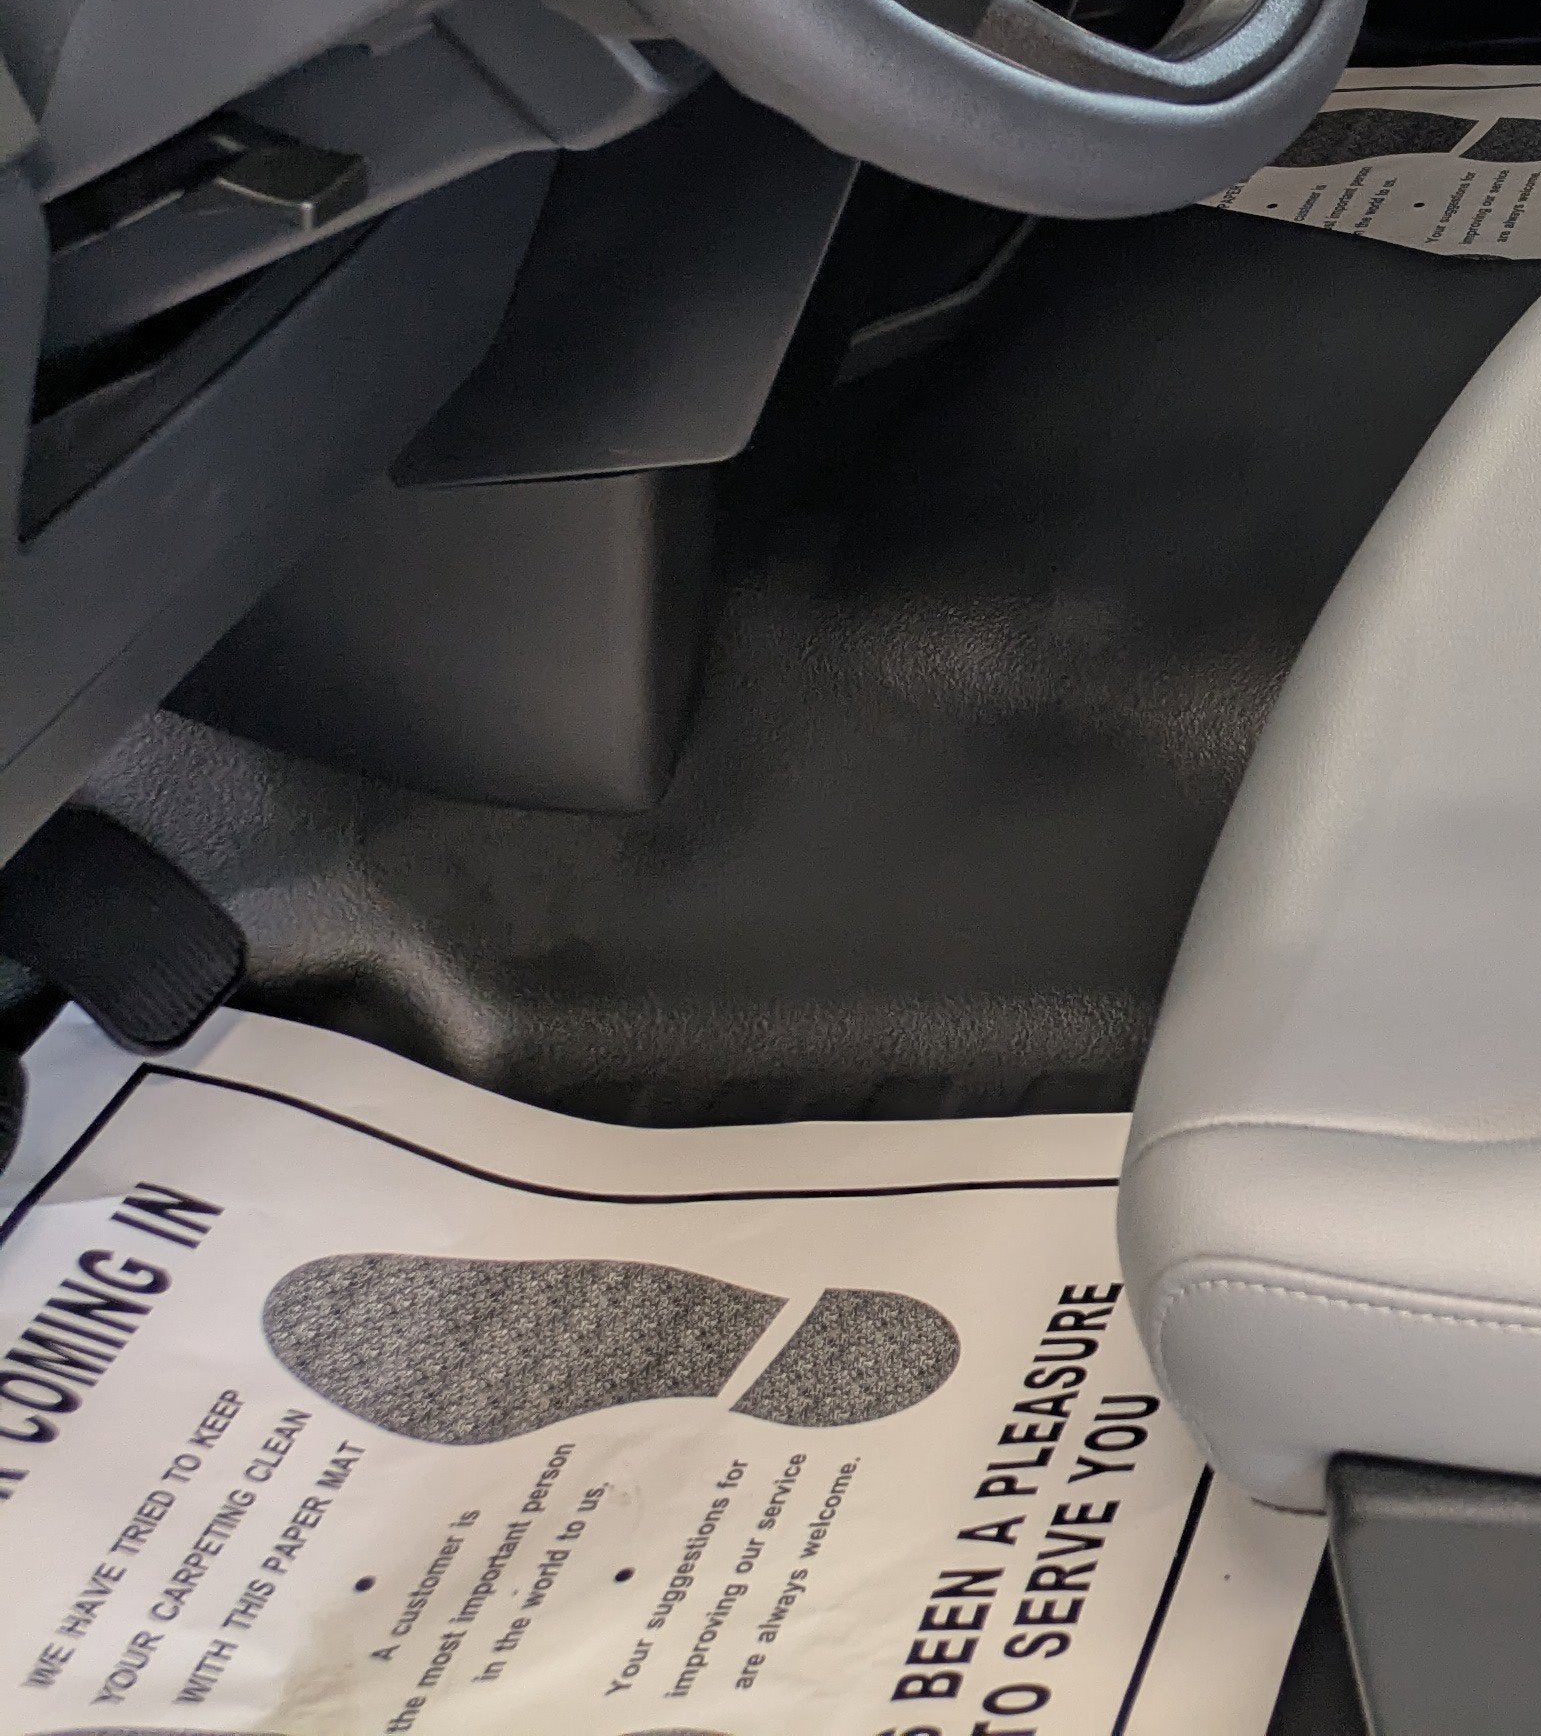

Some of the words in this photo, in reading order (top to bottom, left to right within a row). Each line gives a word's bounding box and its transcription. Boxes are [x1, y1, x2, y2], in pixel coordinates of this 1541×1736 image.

[1424, 224, 1447, 243] Your
[1440, 183, 1471, 224] suggestions
[1460, 171, 1477, 182] for
[1458, 208, 1493, 245] improving
[1482, 195, 1496, 207] our
[1489, 169, 1510, 194] service
[1497, 230, 1511, 243] are
[1502, 204, 1526, 229] always
[0, 1249, 172, 1444] COMING
[110, 1181, 225, 1249] IN
[973, 1281, 1125, 1500] PLEASURE
[21, 1642, 75, 1690] WE
[55, 1562, 128, 1639] HAVE
[108, 1489, 177, 1556] TRIED
[161, 1452, 202, 1484] TO
[188, 1388, 246, 1449] KEEP
[90, 1630, 166, 1706] YOUR
[150, 1488, 259, 1623] CARPETING
[243, 1408, 313, 1484] CLEAN
[172, 1638, 240, 1704] WITH
[221, 1578, 277, 1630] THIS
[260, 1495, 335, 1576] PAPER
[316, 1439, 367, 1491] MAT
[370, 1644, 401, 1661] A
[390, 1535, 465, 1637] customer
[449, 1509, 482, 1528] is
[385, 1695, 428, 1734] the
[416, 1630, 469, 1689] most
[449, 1519, 534, 1625] important
[521, 1442, 577, 1515] person
[470, 1660, 508, 1684] in
[493, 1616, 532, 1653] the
[521, 1548, 573, 1611] world
[555, 1519, 587, 1542] to
[604, 1638, 654, 1697] Your
[646, 1496, 731, 1631] suggestions
[716, 1459, 749, 1490] for
[663, 1582, 749, 1698] improving
[735, 1537, 766, 1575] our
[757, 1453, 808, 1532] service
[734, 1653, 767, 1691] are
[757, 1567, 809, 1644] always
[799, 1456, 862, 1560] welcome.
[889, 1566, 1007, 1703] BEEN
[956, 1514, 1028, 1547] A
[1003, 1499, 1125, 1661] SERVE
[1067, 1393, 1161, 1485] YOU
